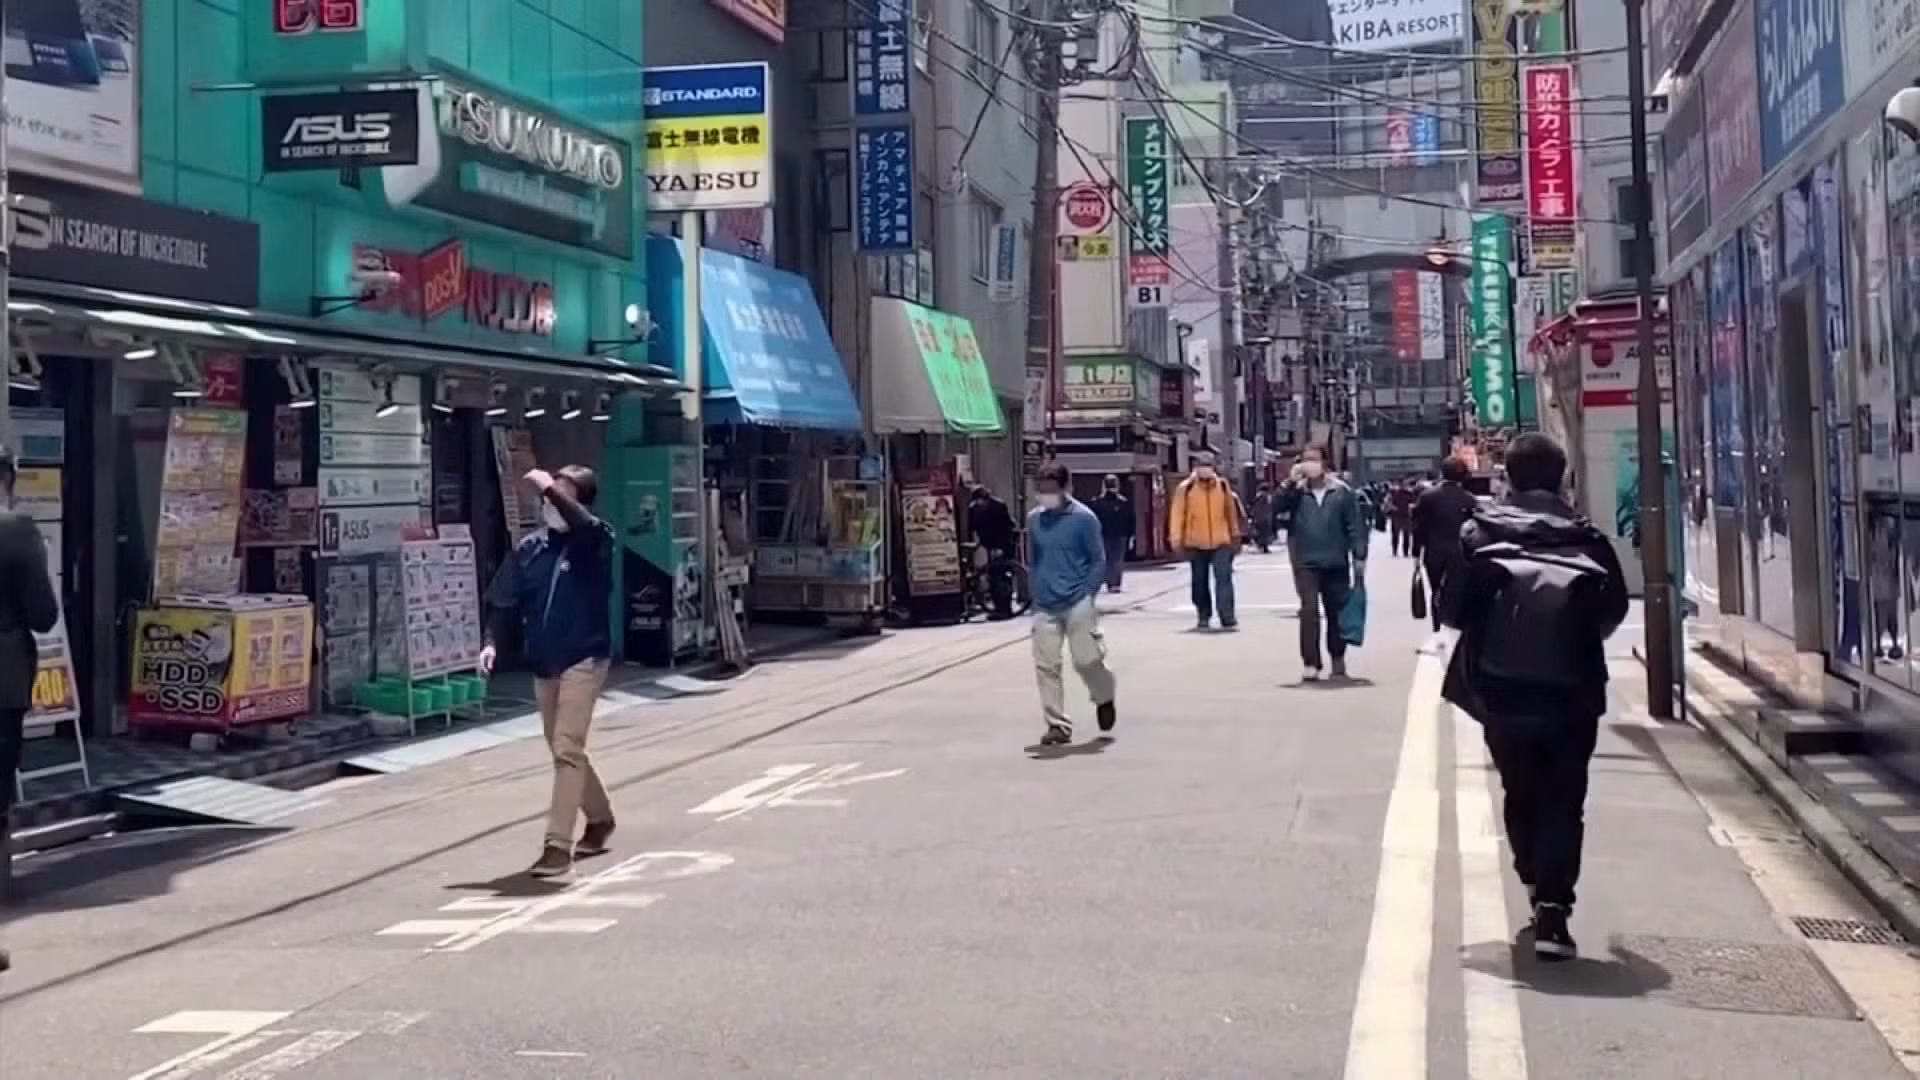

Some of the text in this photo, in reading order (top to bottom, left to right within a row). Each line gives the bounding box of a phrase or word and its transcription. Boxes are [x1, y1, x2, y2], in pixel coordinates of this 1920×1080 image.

[1397, 13, 1458, 35] RESORT
[662, 86, 757, 101] STANDARD
[281, 113, 391, 144] ASUS
[446, 84, 623, 190] TSUKUMO
[647, 171, 761, 193] YAESU
[1144, 123, 1165, 250] メロンブックス
[49, 215, 208, 269] IN SEARCH OF INCREDIBLE
[1138, 286, 1161, 304] B1
[1480, 235, 1505, 422] TSUKUMO
[343, 519, 370, 540] ASUS
[142, 659, 207, 684] HDD
